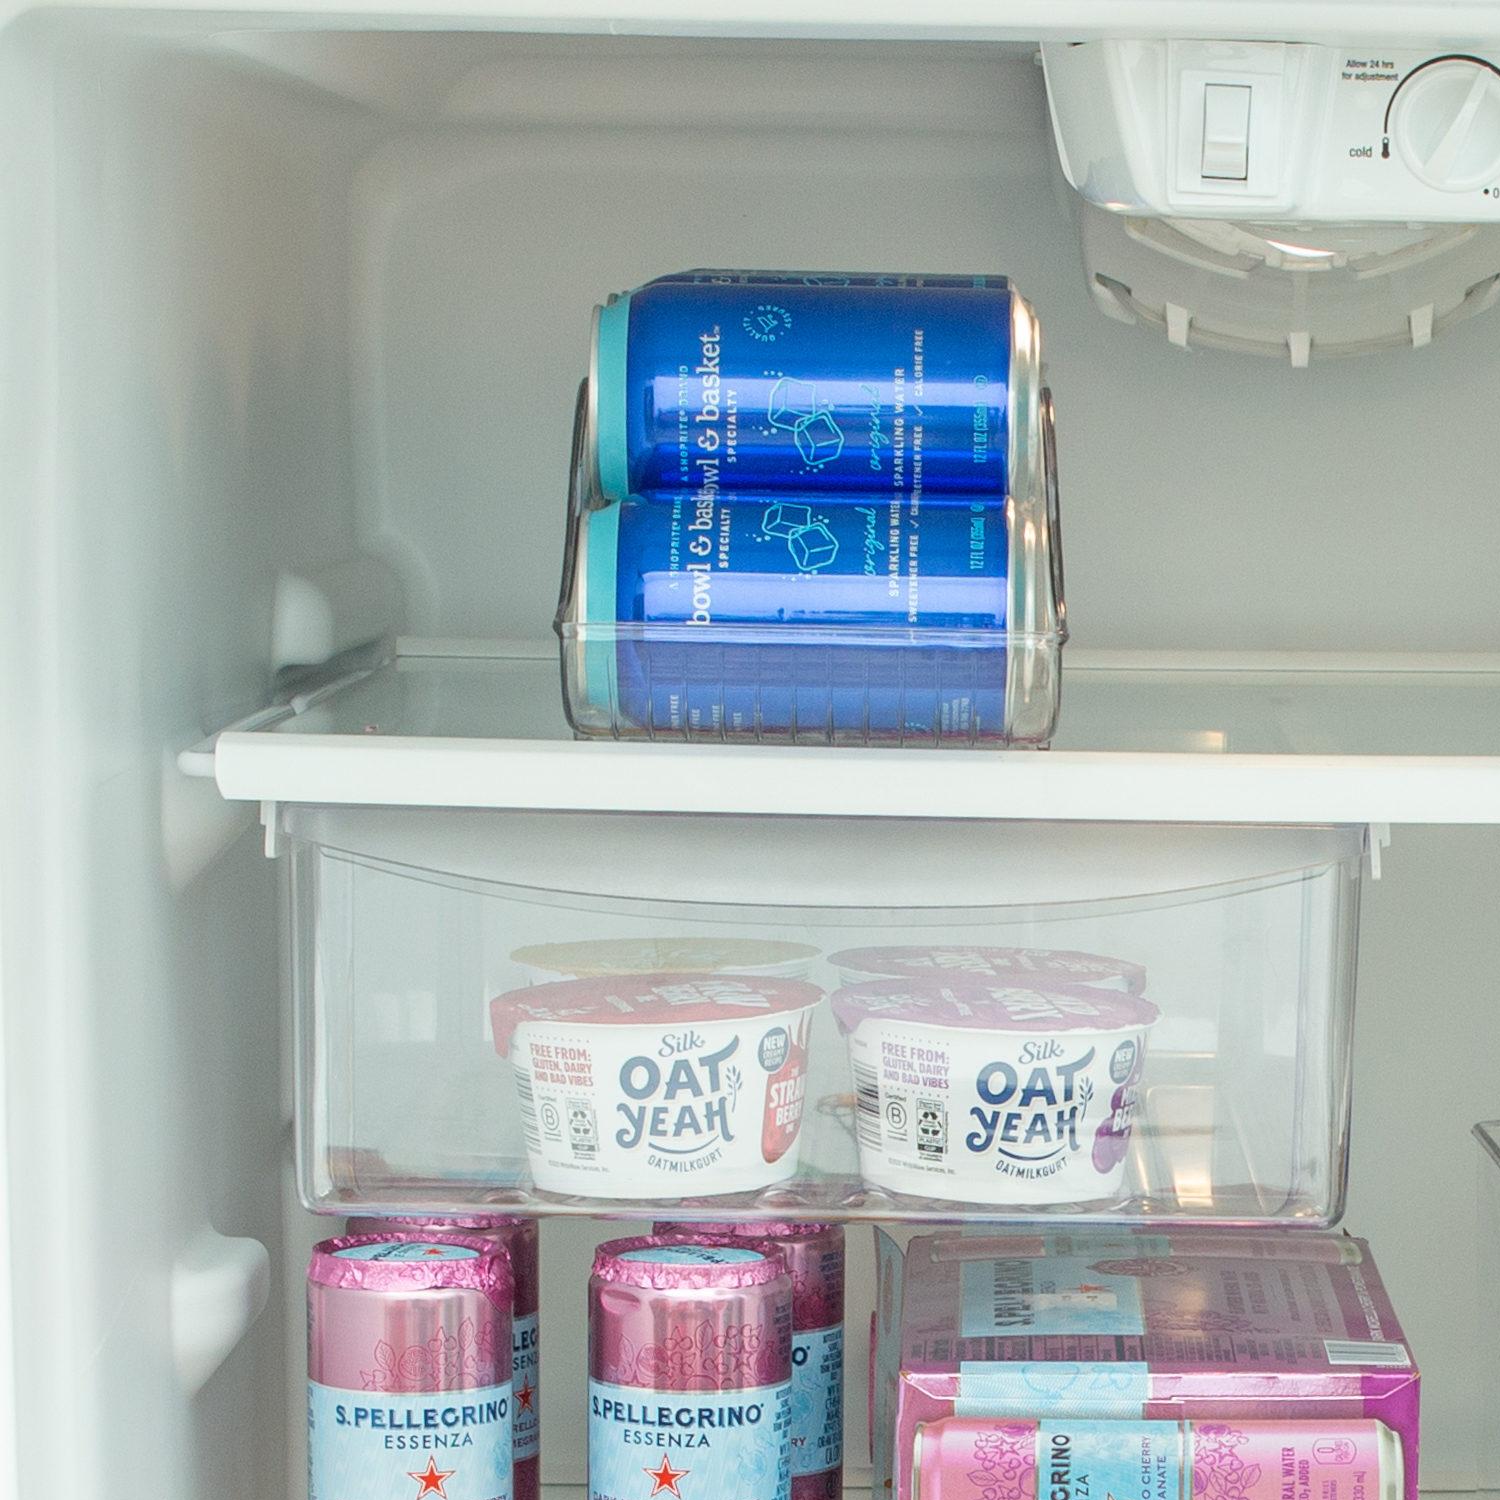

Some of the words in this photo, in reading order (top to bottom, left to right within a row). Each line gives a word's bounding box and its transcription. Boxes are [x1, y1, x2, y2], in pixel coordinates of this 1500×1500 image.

[1342, 71, 1353, 80] for
[1355, 72, 1399, 83] adjustment
[1345, 59, 1367, 69] Allow
[1370, 60, 1380, 69] 24
[1381, 60, 1394, 69] hrs
[1349, 147, 1372, 158] cold
[696, 333, 721, 422] basket
[894, 368, 905, 413] WATER
[698, 428, 720, 451] &
[727, 389, 738, 463] SPECIALTY
[860, 382, 890, 470] original
[894, 419, 905, 487] SPARKLING
[689, 535, 712, 556] &
[719, 508, 731, 569] SPECIALTY
[854, 506, 885, 576] original
[889, 528, 900, 598] SPARKLING
[686, 563, 712, 626] bowl
[530, 1043, 554, 1060] FREE
[555, 1047, 591, 1062] FROM:
[658, 1030, 706, 1057] Silk
[763, 1033, 786, 1051] NEW
[881, 1041, 908, 1058] FREE
[910, 1045, 949, 1064] FROM:
[1018, 1039, 1064, 1065] Silk
[563, 1061, 592, 1075] DAIRY
[567, 1074, 593, 1087] VIBES
[619, 1034, 740, 1101] OAT
[918, 1063, 950, 1076] DAIRY
[976, 1046, 1096, 1108] OAT
[922, 1075, 950, 1090] VIBES
[615, 1095, 735, 1149] YEAH
[965, 1106, 1082, 1153] YEAH
[647, 1148, 723, 1173] OATMILKGURT
[995, 1156, 1069, 1180] OATMILKGURT
[336, 1397, 508, 1430] S.PELLEGRINO
[592, 1396, 762, 1428] S.PELLEGRINO
[384, 1432, 473, 1449] ESSENZA
[623, 1429, 711, 1448] ESSENZA
[1142, 1436, 1152, 1485] CHERRY
[1282, 1446, 1295, 1478] WATER
[1299, 1459, 1310, 1487] ADDED
